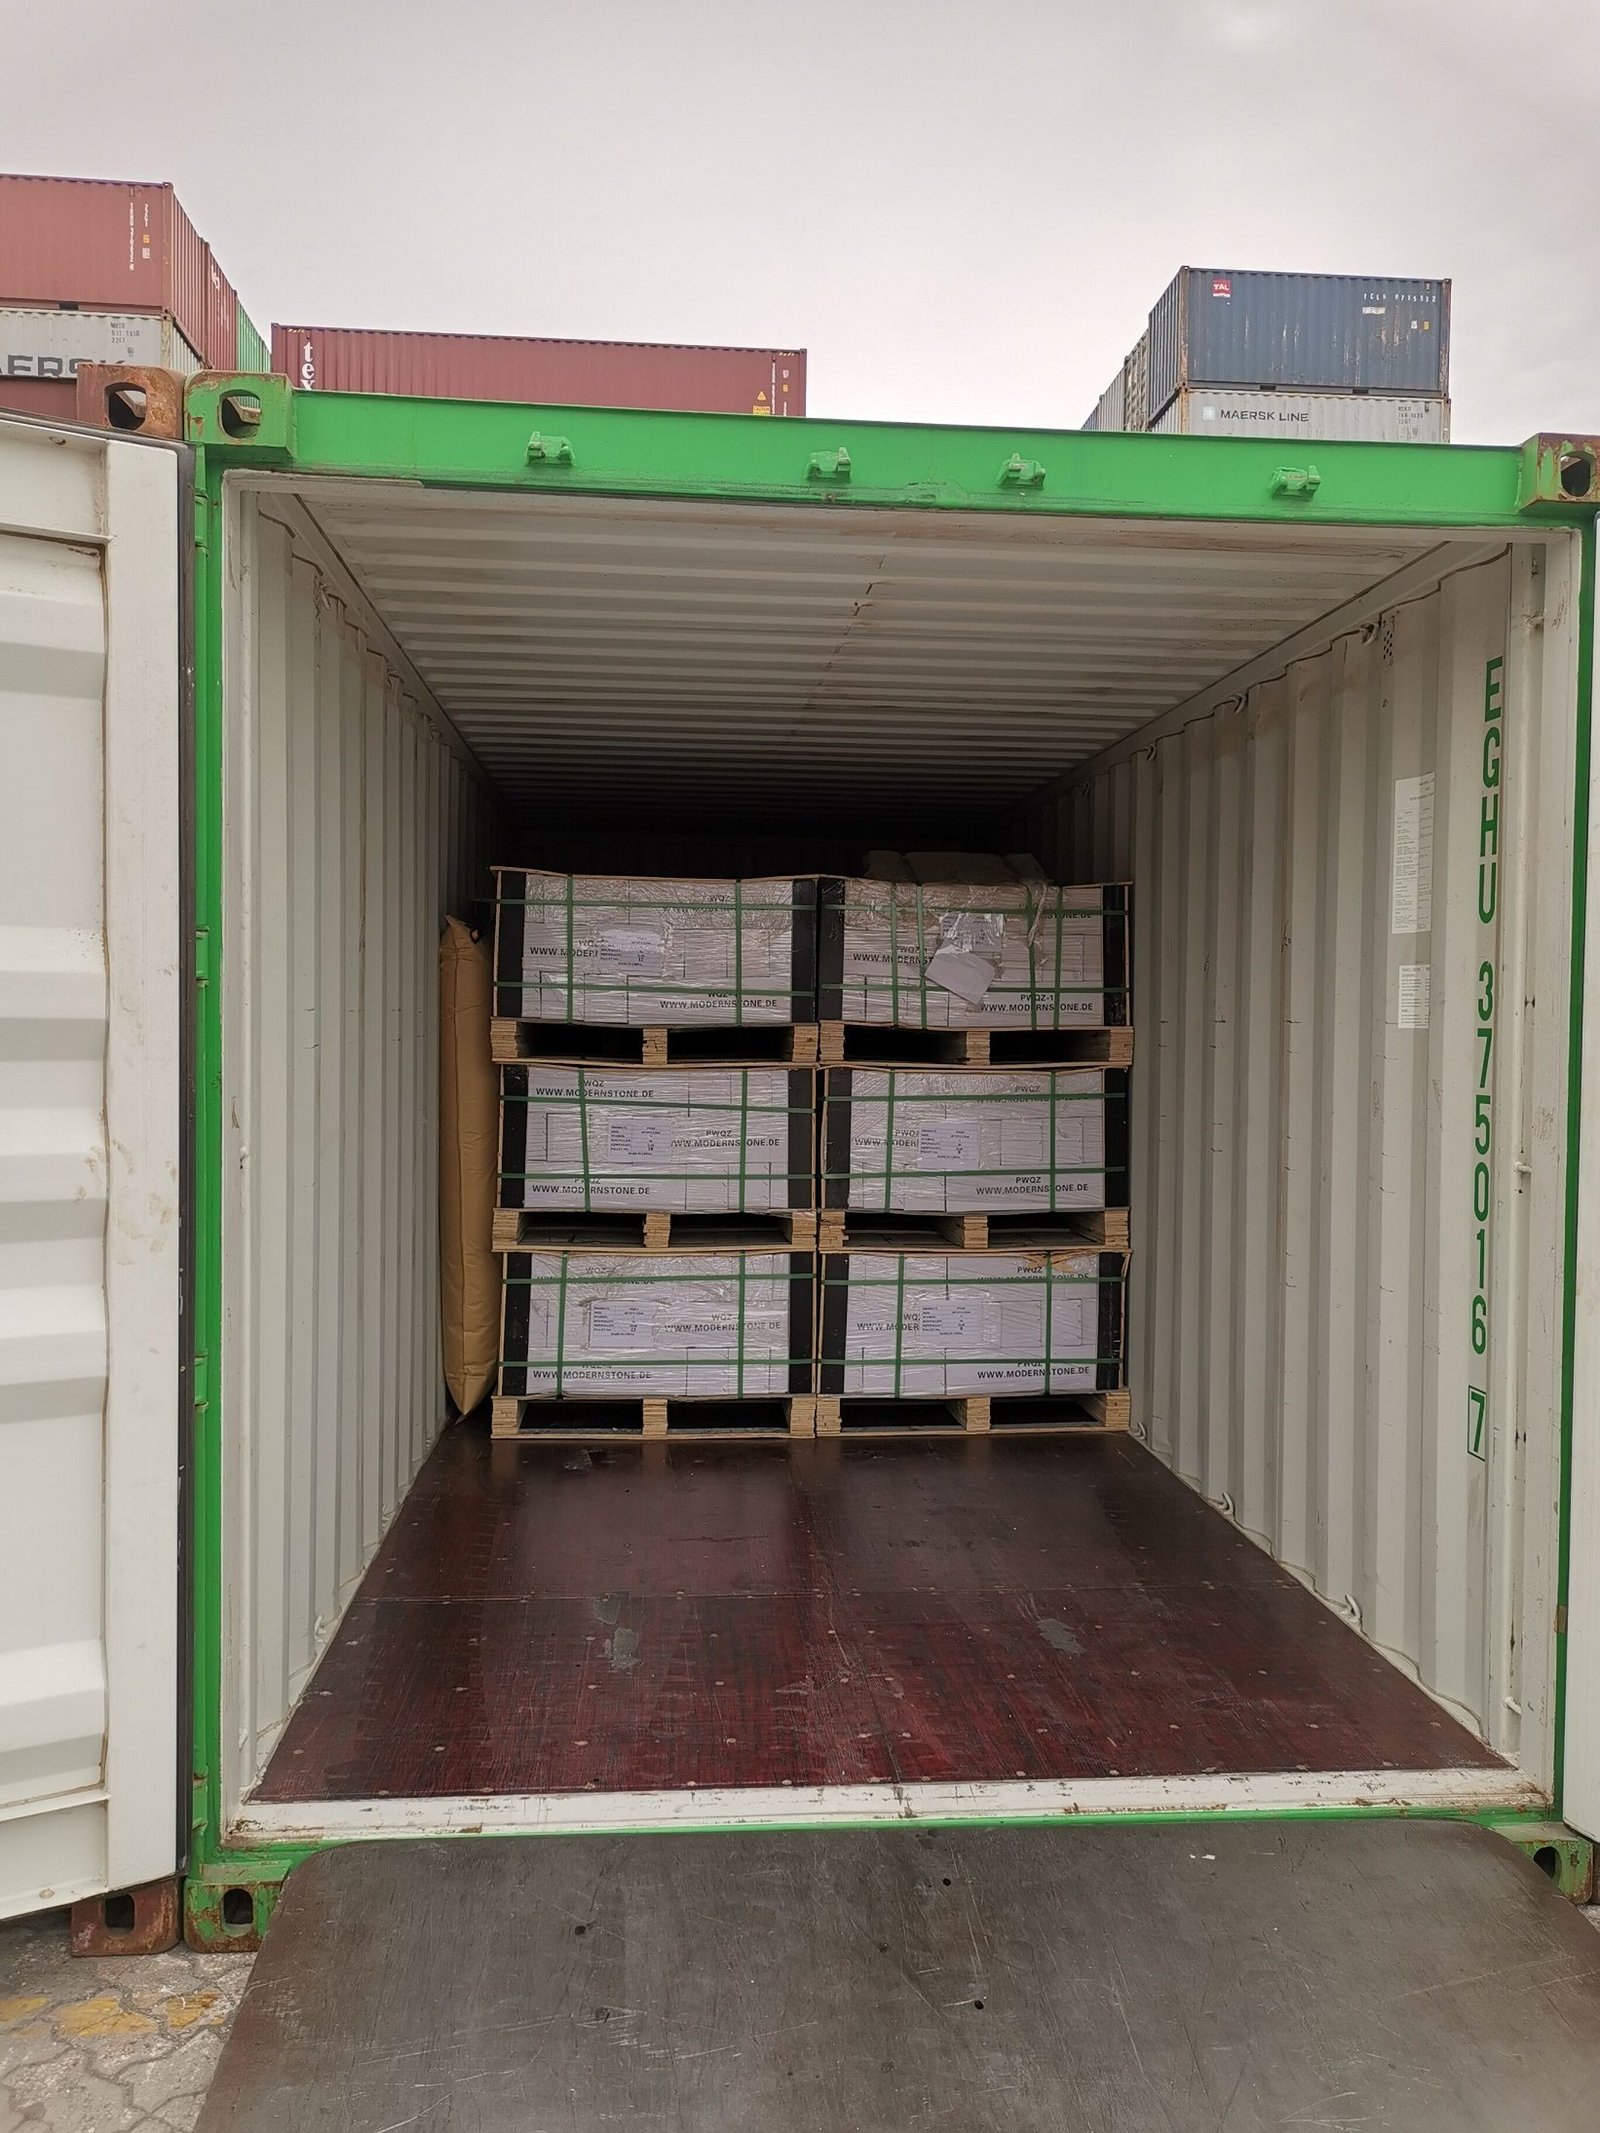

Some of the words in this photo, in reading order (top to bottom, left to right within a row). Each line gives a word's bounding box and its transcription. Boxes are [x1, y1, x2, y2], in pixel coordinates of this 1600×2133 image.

[1213, 283, 1229, 291] TAL
[1220, 409, 1275, 420] MAERSK
[1279, 412, 1309, 421] LINE
[1478, 656, 1503, 924] EGHU
[660, 999, 777, 1009] WWW.MODERNSONE.DE
[981, 1003, 1093, 1012] WWW.MODRNSONE.DE
[1472, 961, 1494, 1354] 375016
[1016, 1176, 1042, 1184] PWQZ
[532, 1185, 650, 1195] WWW.MODRNSTONE.DE
[976, 1184, 1089, 1195] WWW.MODERNSONE.DE
[977, 1366, 1090, 1379] WWW.MODERNTONE.DE
[1471, 1391, 1485, 1453] 7
